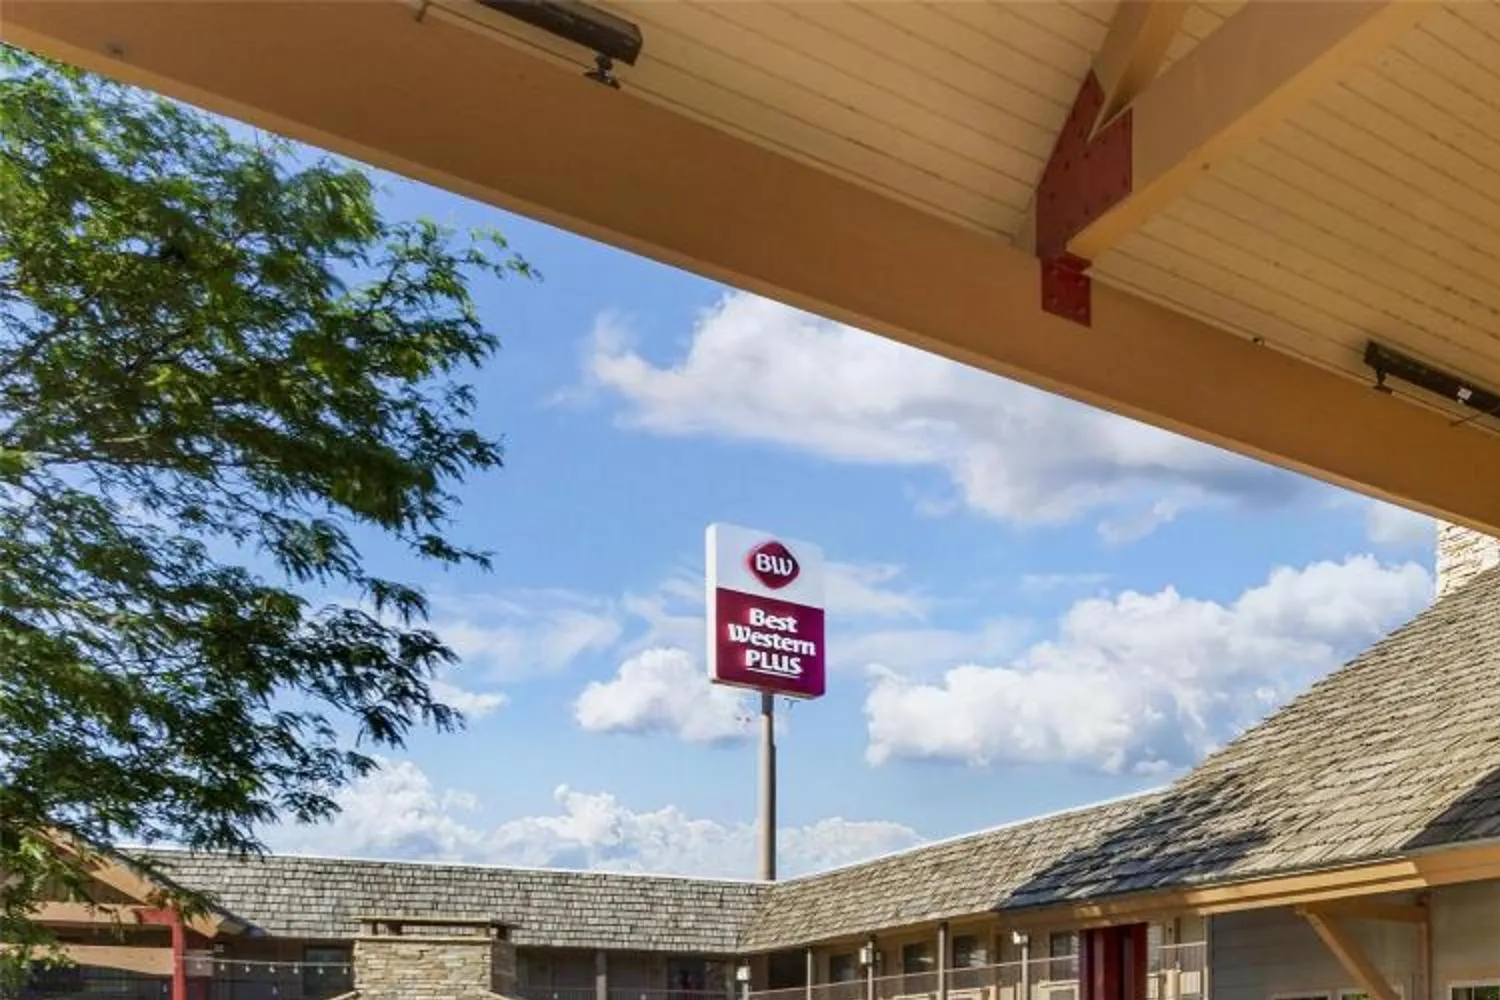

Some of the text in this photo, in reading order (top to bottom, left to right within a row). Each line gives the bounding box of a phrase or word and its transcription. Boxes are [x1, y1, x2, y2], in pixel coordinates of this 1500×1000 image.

[755, 552, 794, 576] BW
[749, 607, 799, 633] Best
[727, 623, 816, 656] Western
[744, 649, 803, 674] PLUS
